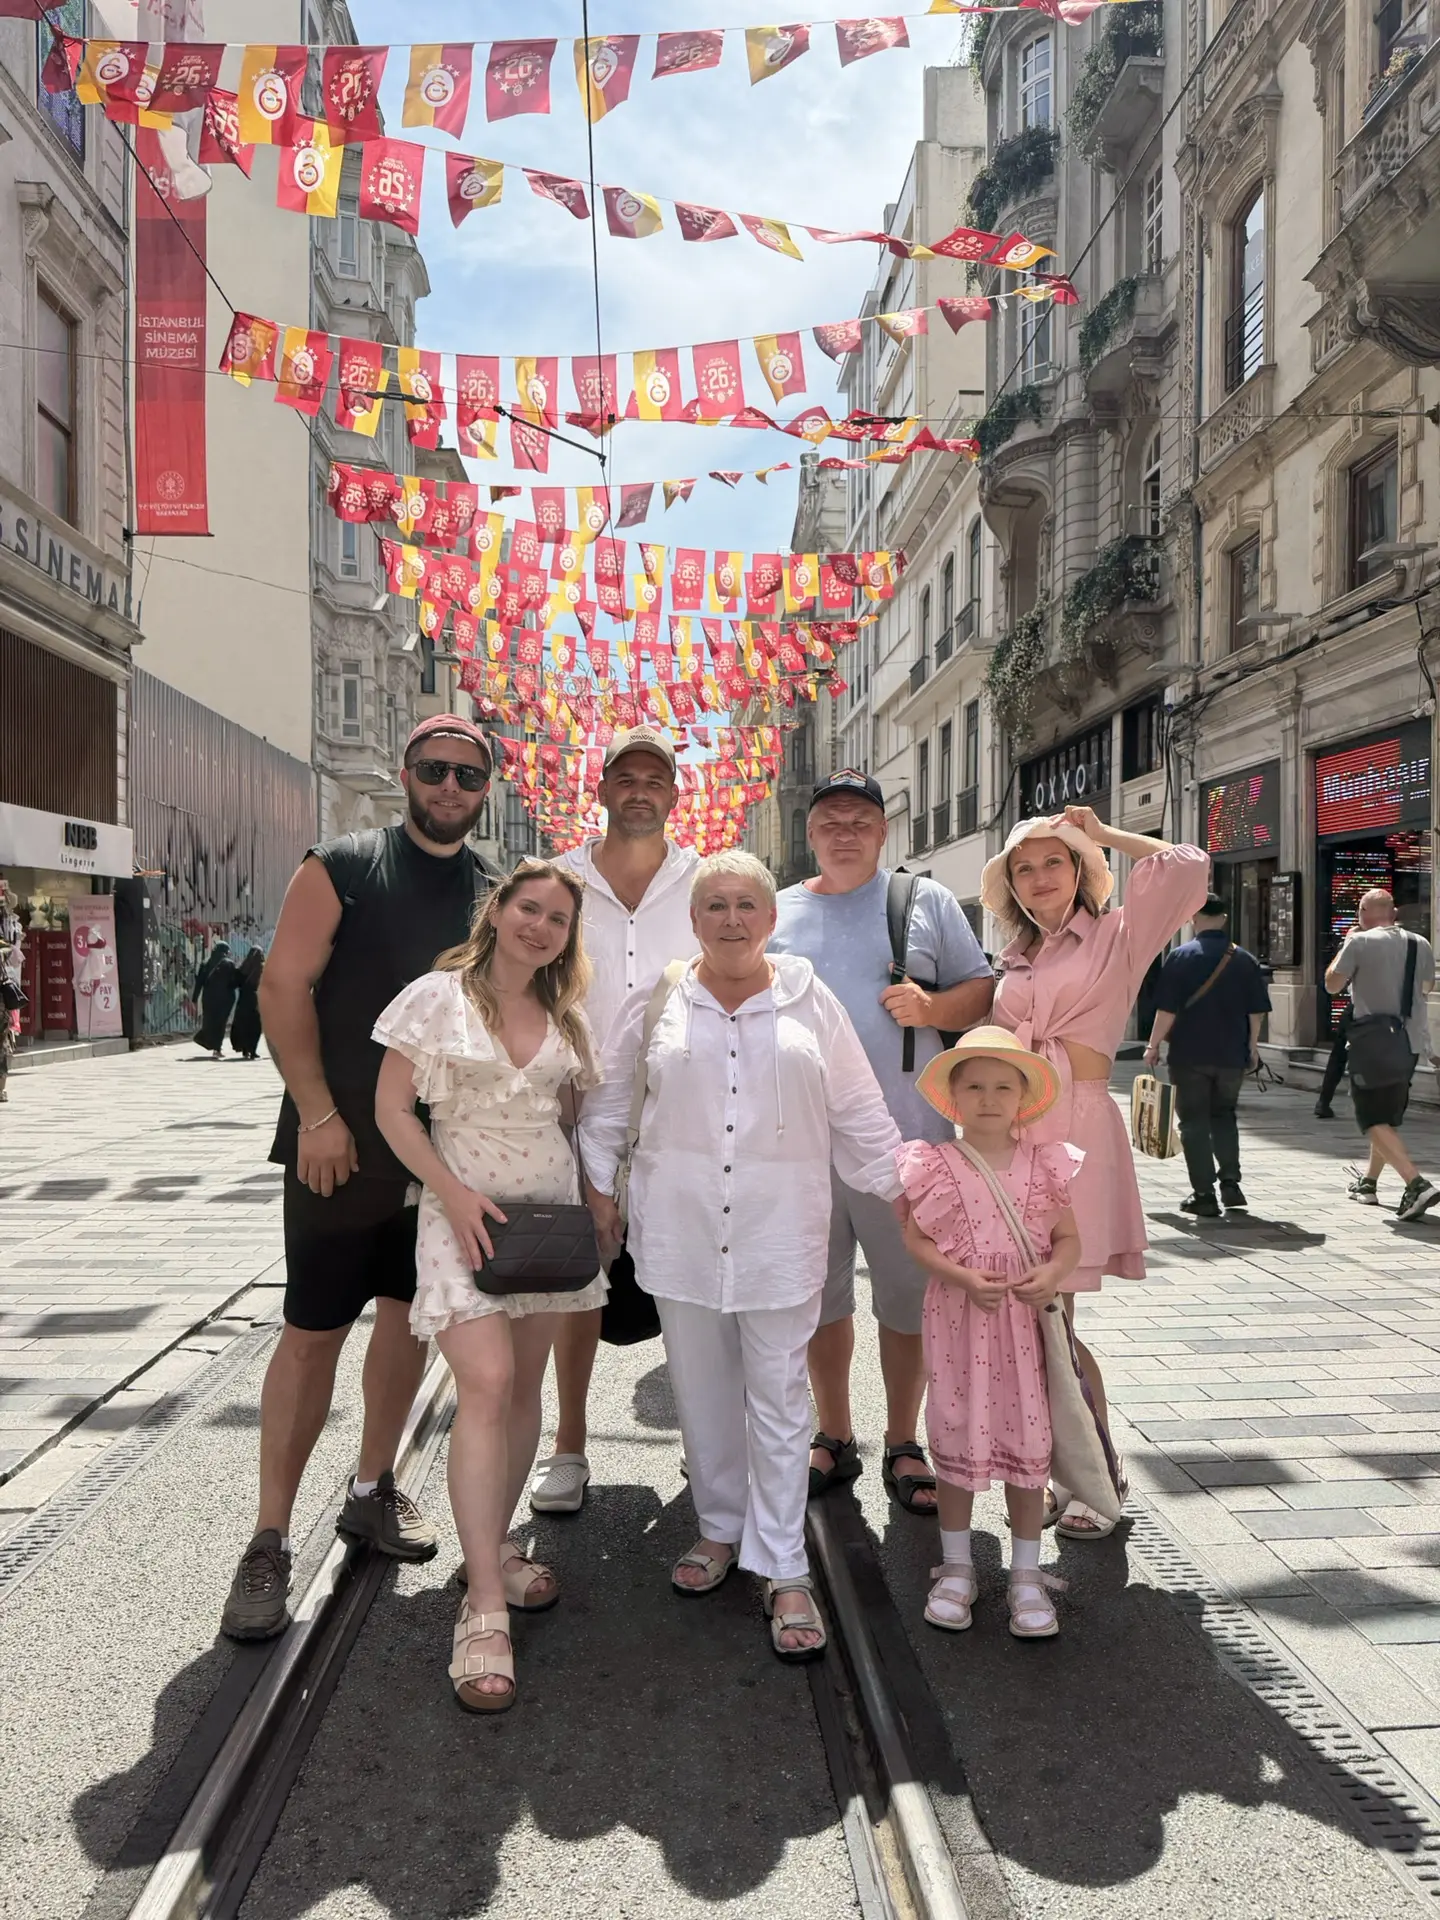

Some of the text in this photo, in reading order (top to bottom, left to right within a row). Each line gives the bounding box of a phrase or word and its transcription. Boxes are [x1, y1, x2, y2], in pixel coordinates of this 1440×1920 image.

[138, 314, 205, 328] İSTANBUL
[144, 330, 198, 344] SİNEMA
[146, 345, 197, 359] MÜZESİ
[708, 366, 729, 390] 26
[1035, 764, 1086, 810] OXXO
[64, 821, 98, 851] NBB
[60, 853, 95, 868] Lingerie
[99, 985, 112, 995] PAY
[103, 996, 110, 1009] 2
